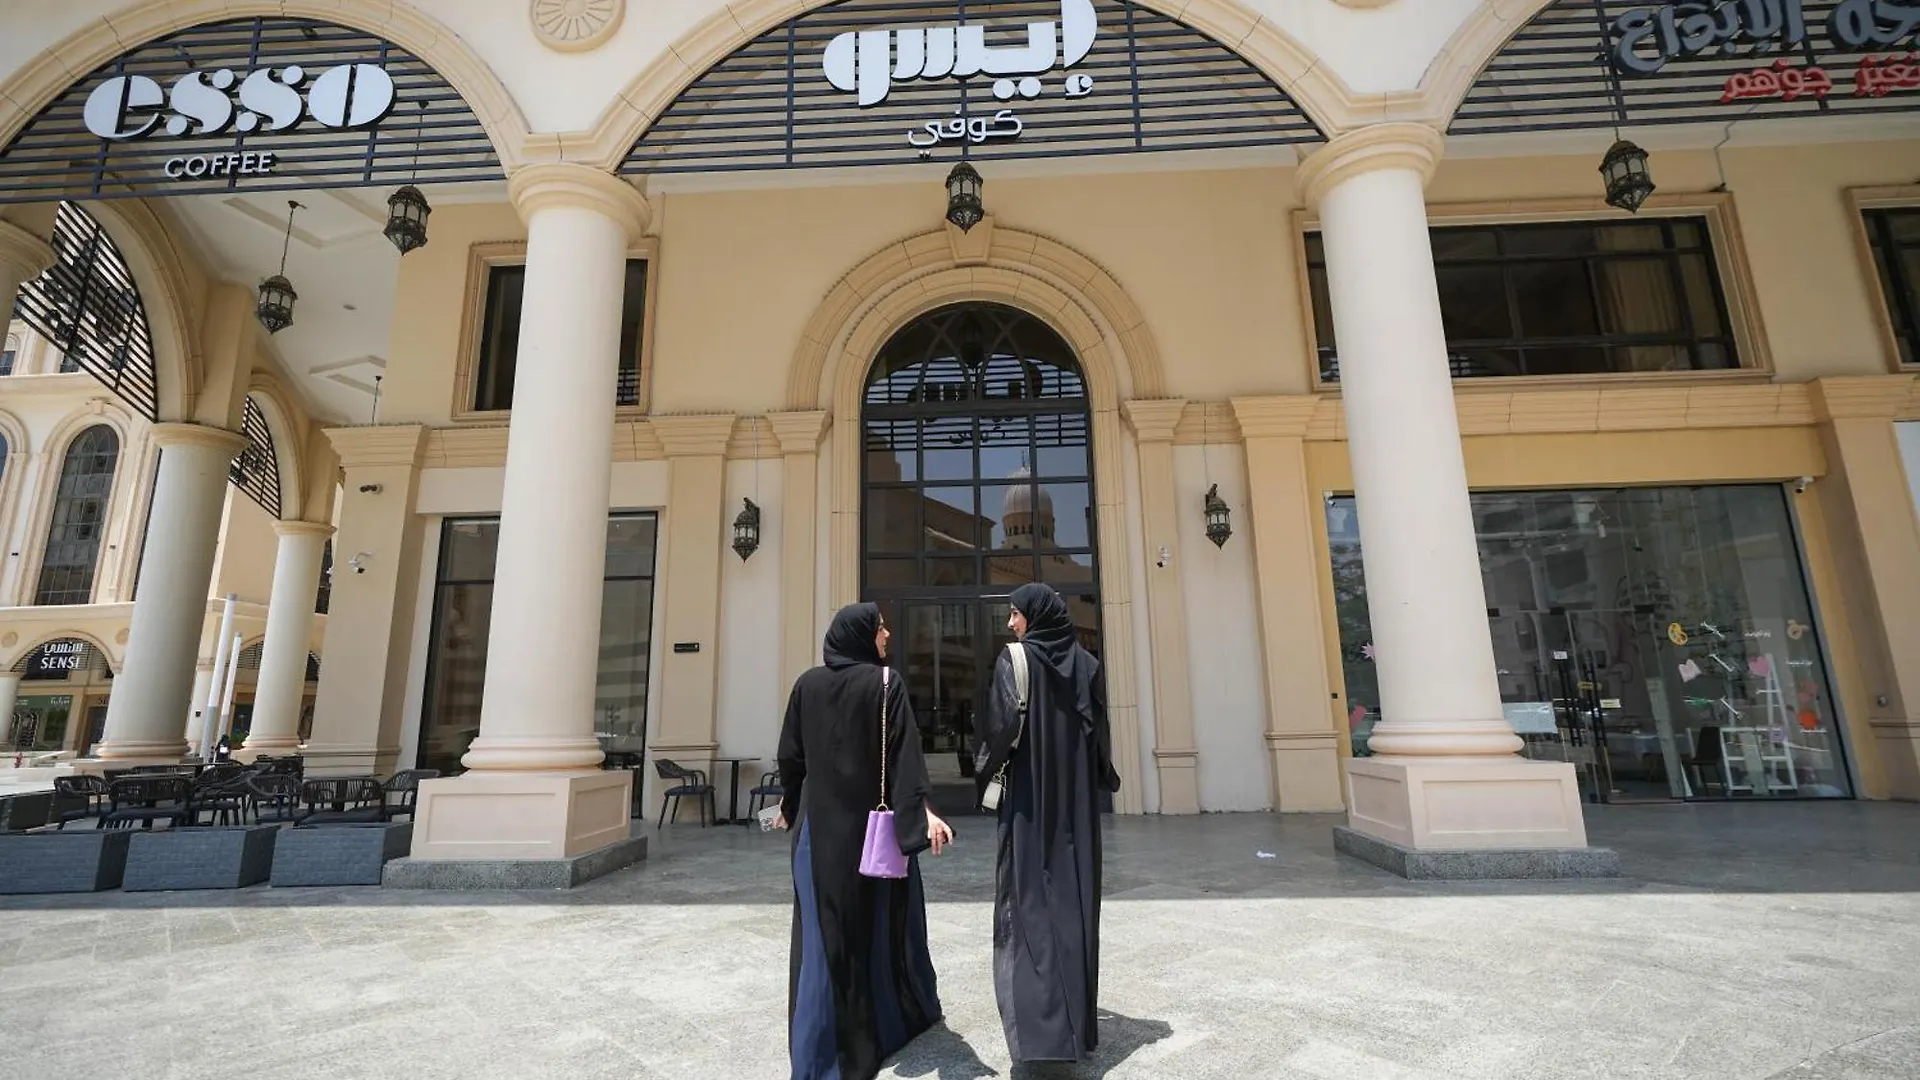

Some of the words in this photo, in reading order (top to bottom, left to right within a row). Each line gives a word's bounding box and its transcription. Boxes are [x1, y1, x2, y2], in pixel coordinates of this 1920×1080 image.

[84, 64, 395, 139] esso
[907, 104, 1023, 159] كوفي
[164, 152, 273, 179] COFFEE
[40, 656, 80, 670] SENSI
